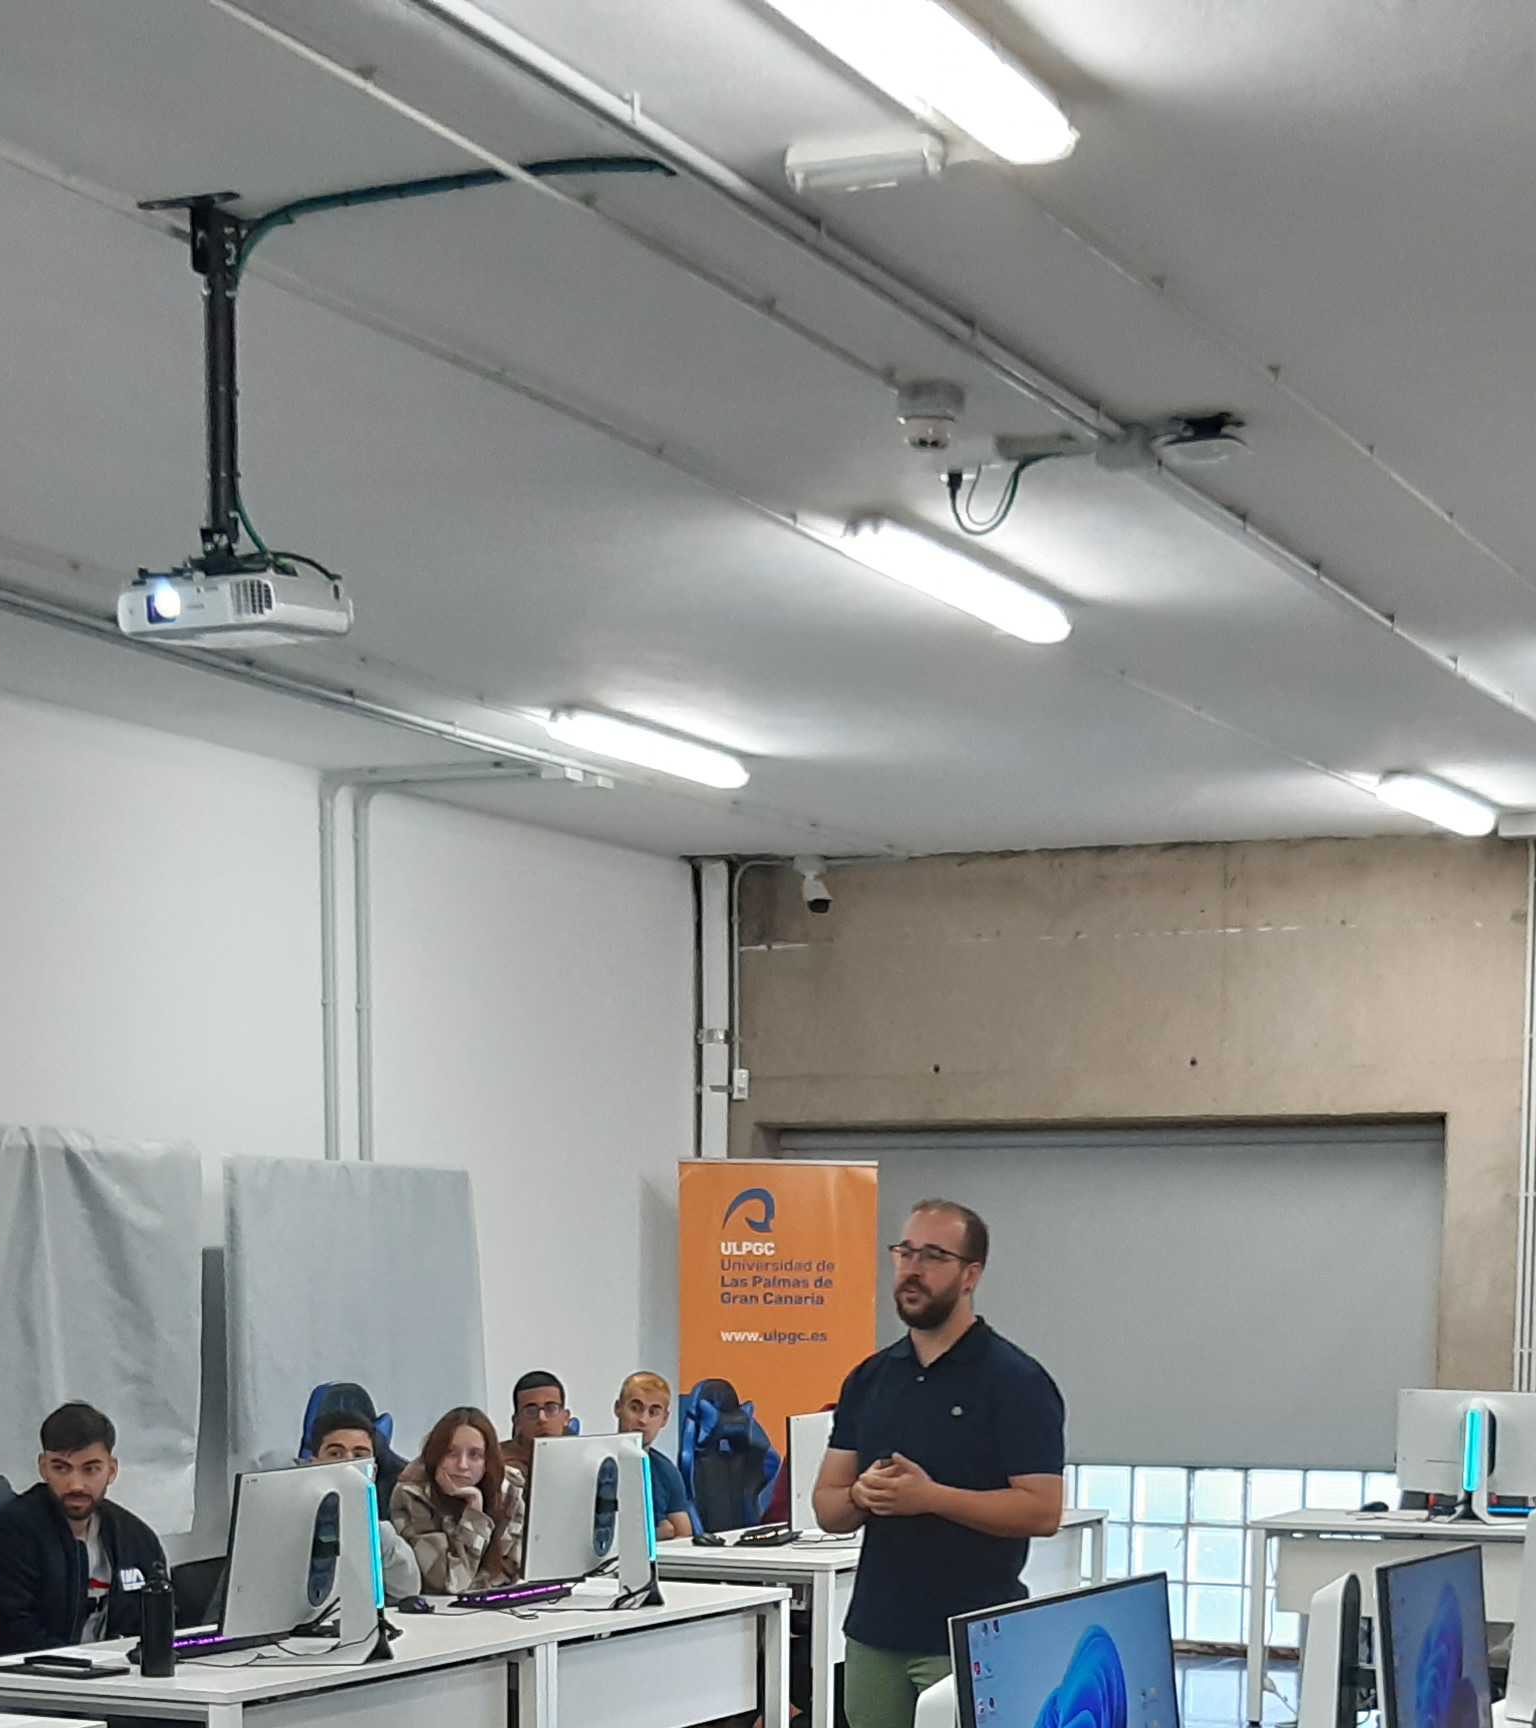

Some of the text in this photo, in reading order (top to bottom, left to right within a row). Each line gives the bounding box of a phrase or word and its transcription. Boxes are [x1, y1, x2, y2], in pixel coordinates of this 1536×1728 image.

[720, 1242, 775, 1255] ULPGC
[720, 1259, 835, 1272] Universidad de
[720, 1276, 833, 1288] Las Palmas de
[720, 1292, 824, 1305] Gran Canaria
[720, 1330, 827, 1344] www.ulpgc.es
